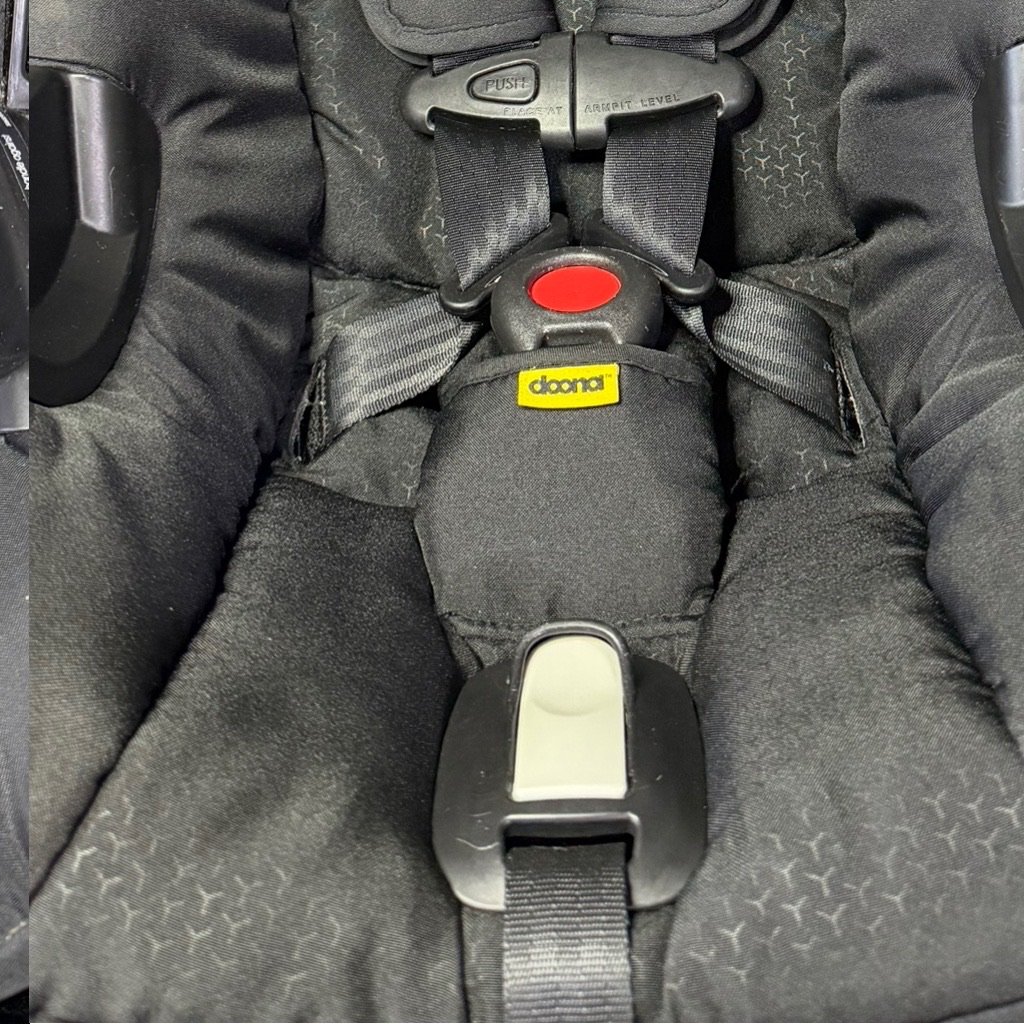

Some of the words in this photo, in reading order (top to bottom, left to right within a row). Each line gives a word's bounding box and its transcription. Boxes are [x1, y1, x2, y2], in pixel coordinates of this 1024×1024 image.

[484, 76, 527, 93] PUSH
[503, 106, 542, 116] PLACE
[547, 106, 563, 116] AT
[584, 100, 633, 114] ARMPIT
[640, 94, 682, 108] LEVEL
[528, 374, 604, 394] doona
